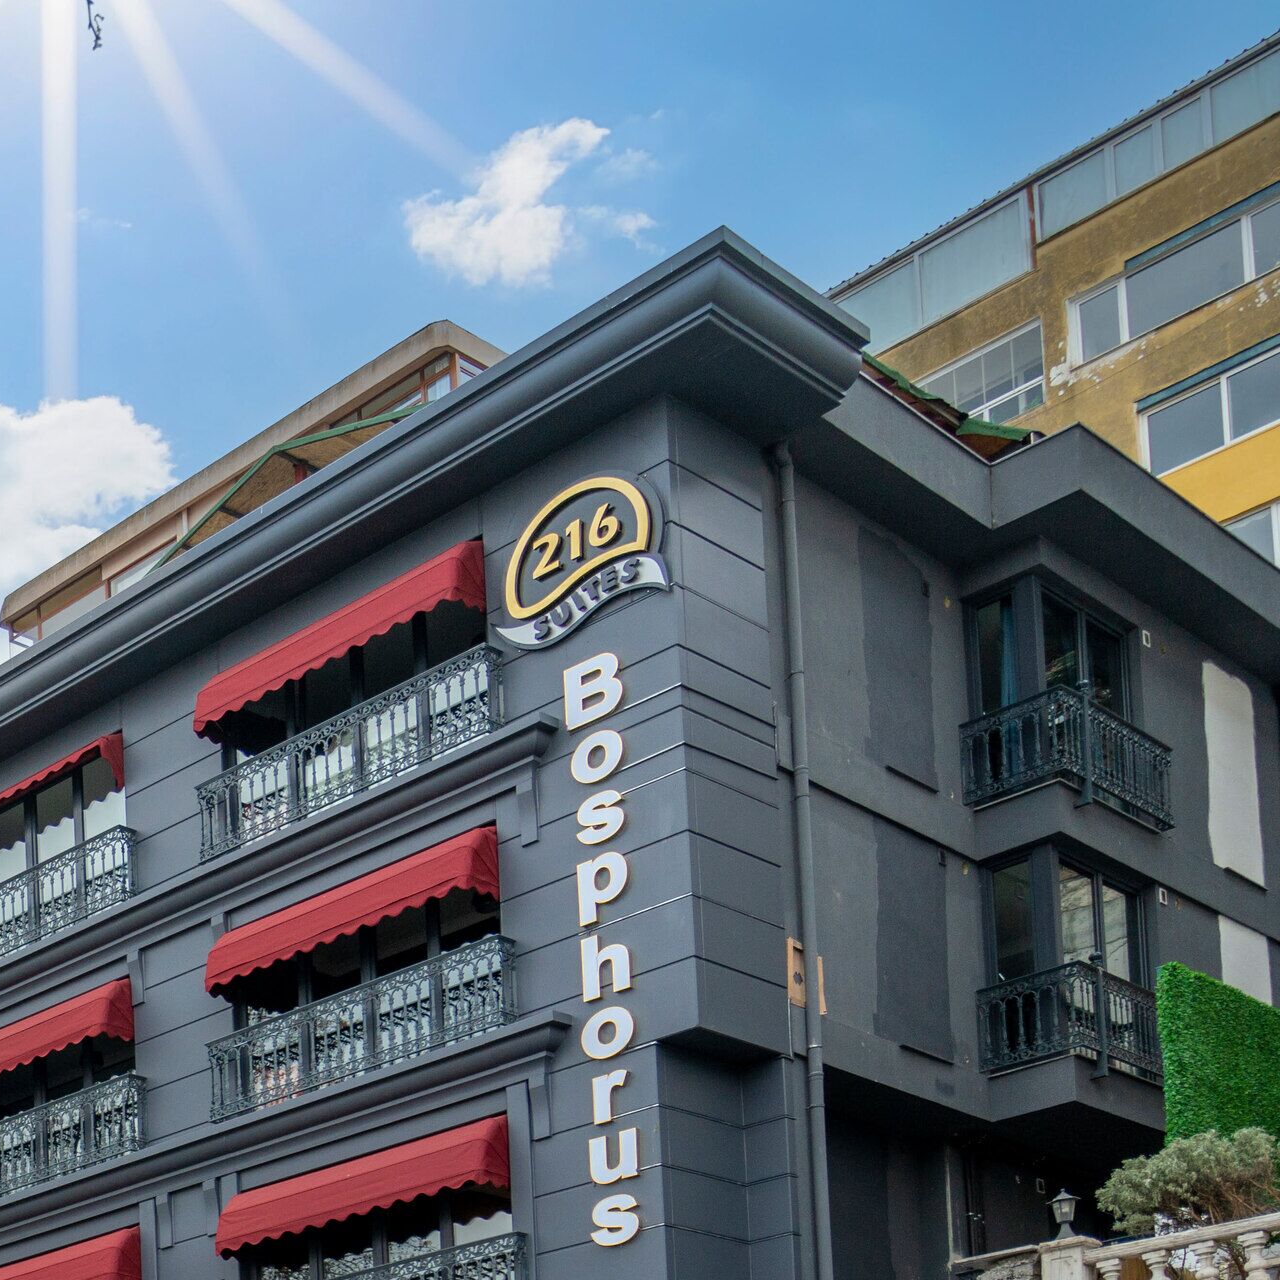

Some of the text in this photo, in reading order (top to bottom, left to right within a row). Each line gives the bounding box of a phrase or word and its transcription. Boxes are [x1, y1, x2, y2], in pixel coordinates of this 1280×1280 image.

[532, 503, 621, 580] 216
[533, 557, 640, 641] SUITES
[562, 651, 641, 1247] Bosphorus
